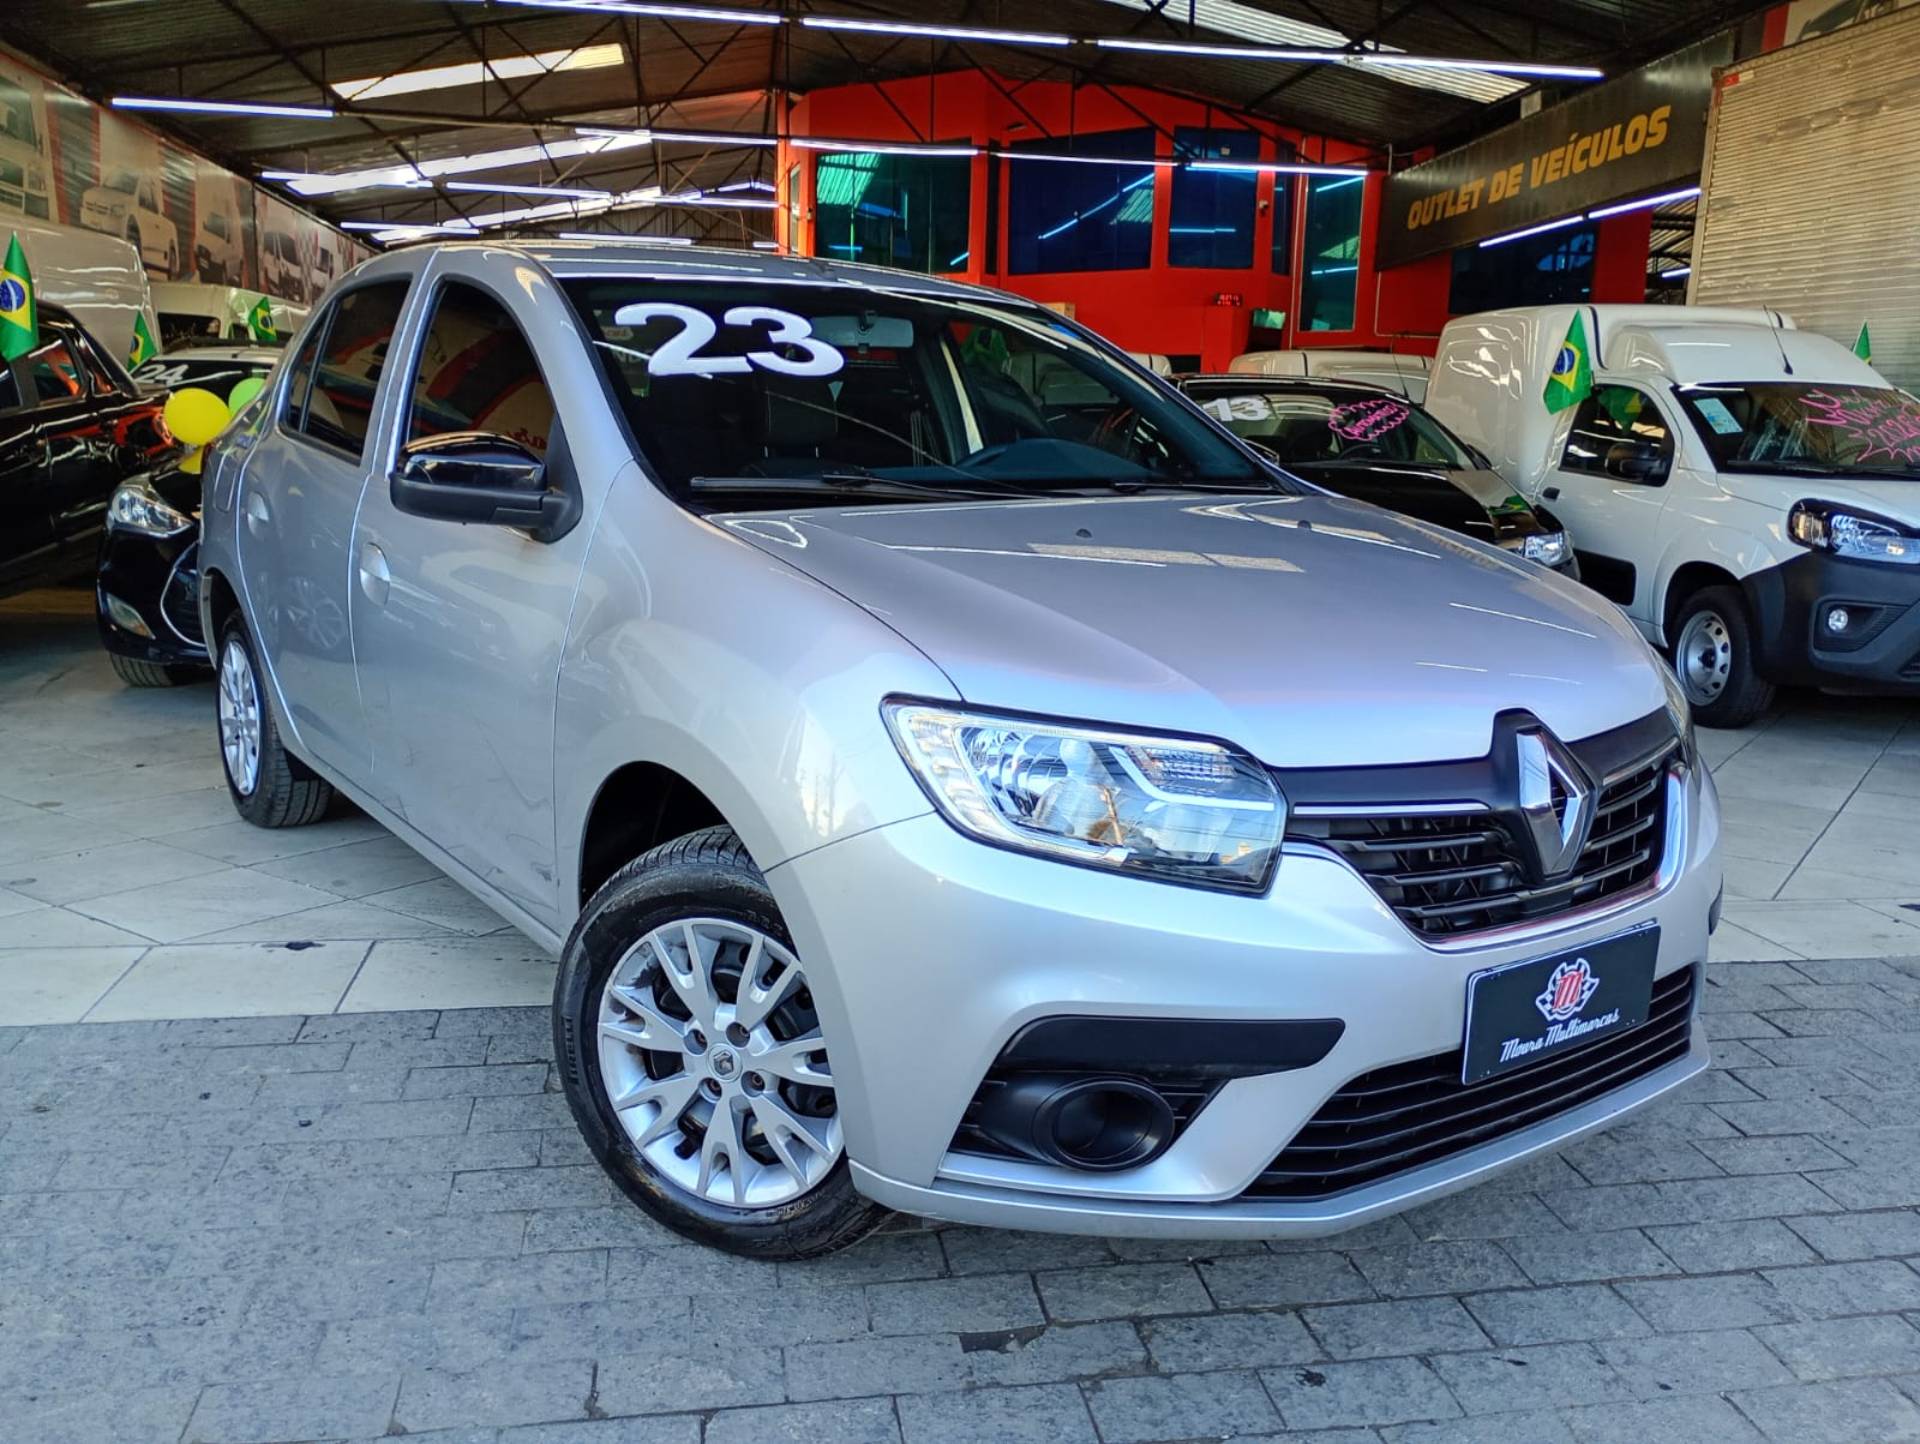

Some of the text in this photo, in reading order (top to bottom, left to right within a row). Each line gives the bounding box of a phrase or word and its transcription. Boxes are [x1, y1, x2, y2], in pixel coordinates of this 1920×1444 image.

[1407, 104, 1672, 231] OUTLET DE VEÍCULOS
[614, 302, 844, 377] 23
[133, 364, 189, 387] 24
[1499, 1007, 1620, 1063] Moura Multimarcas
